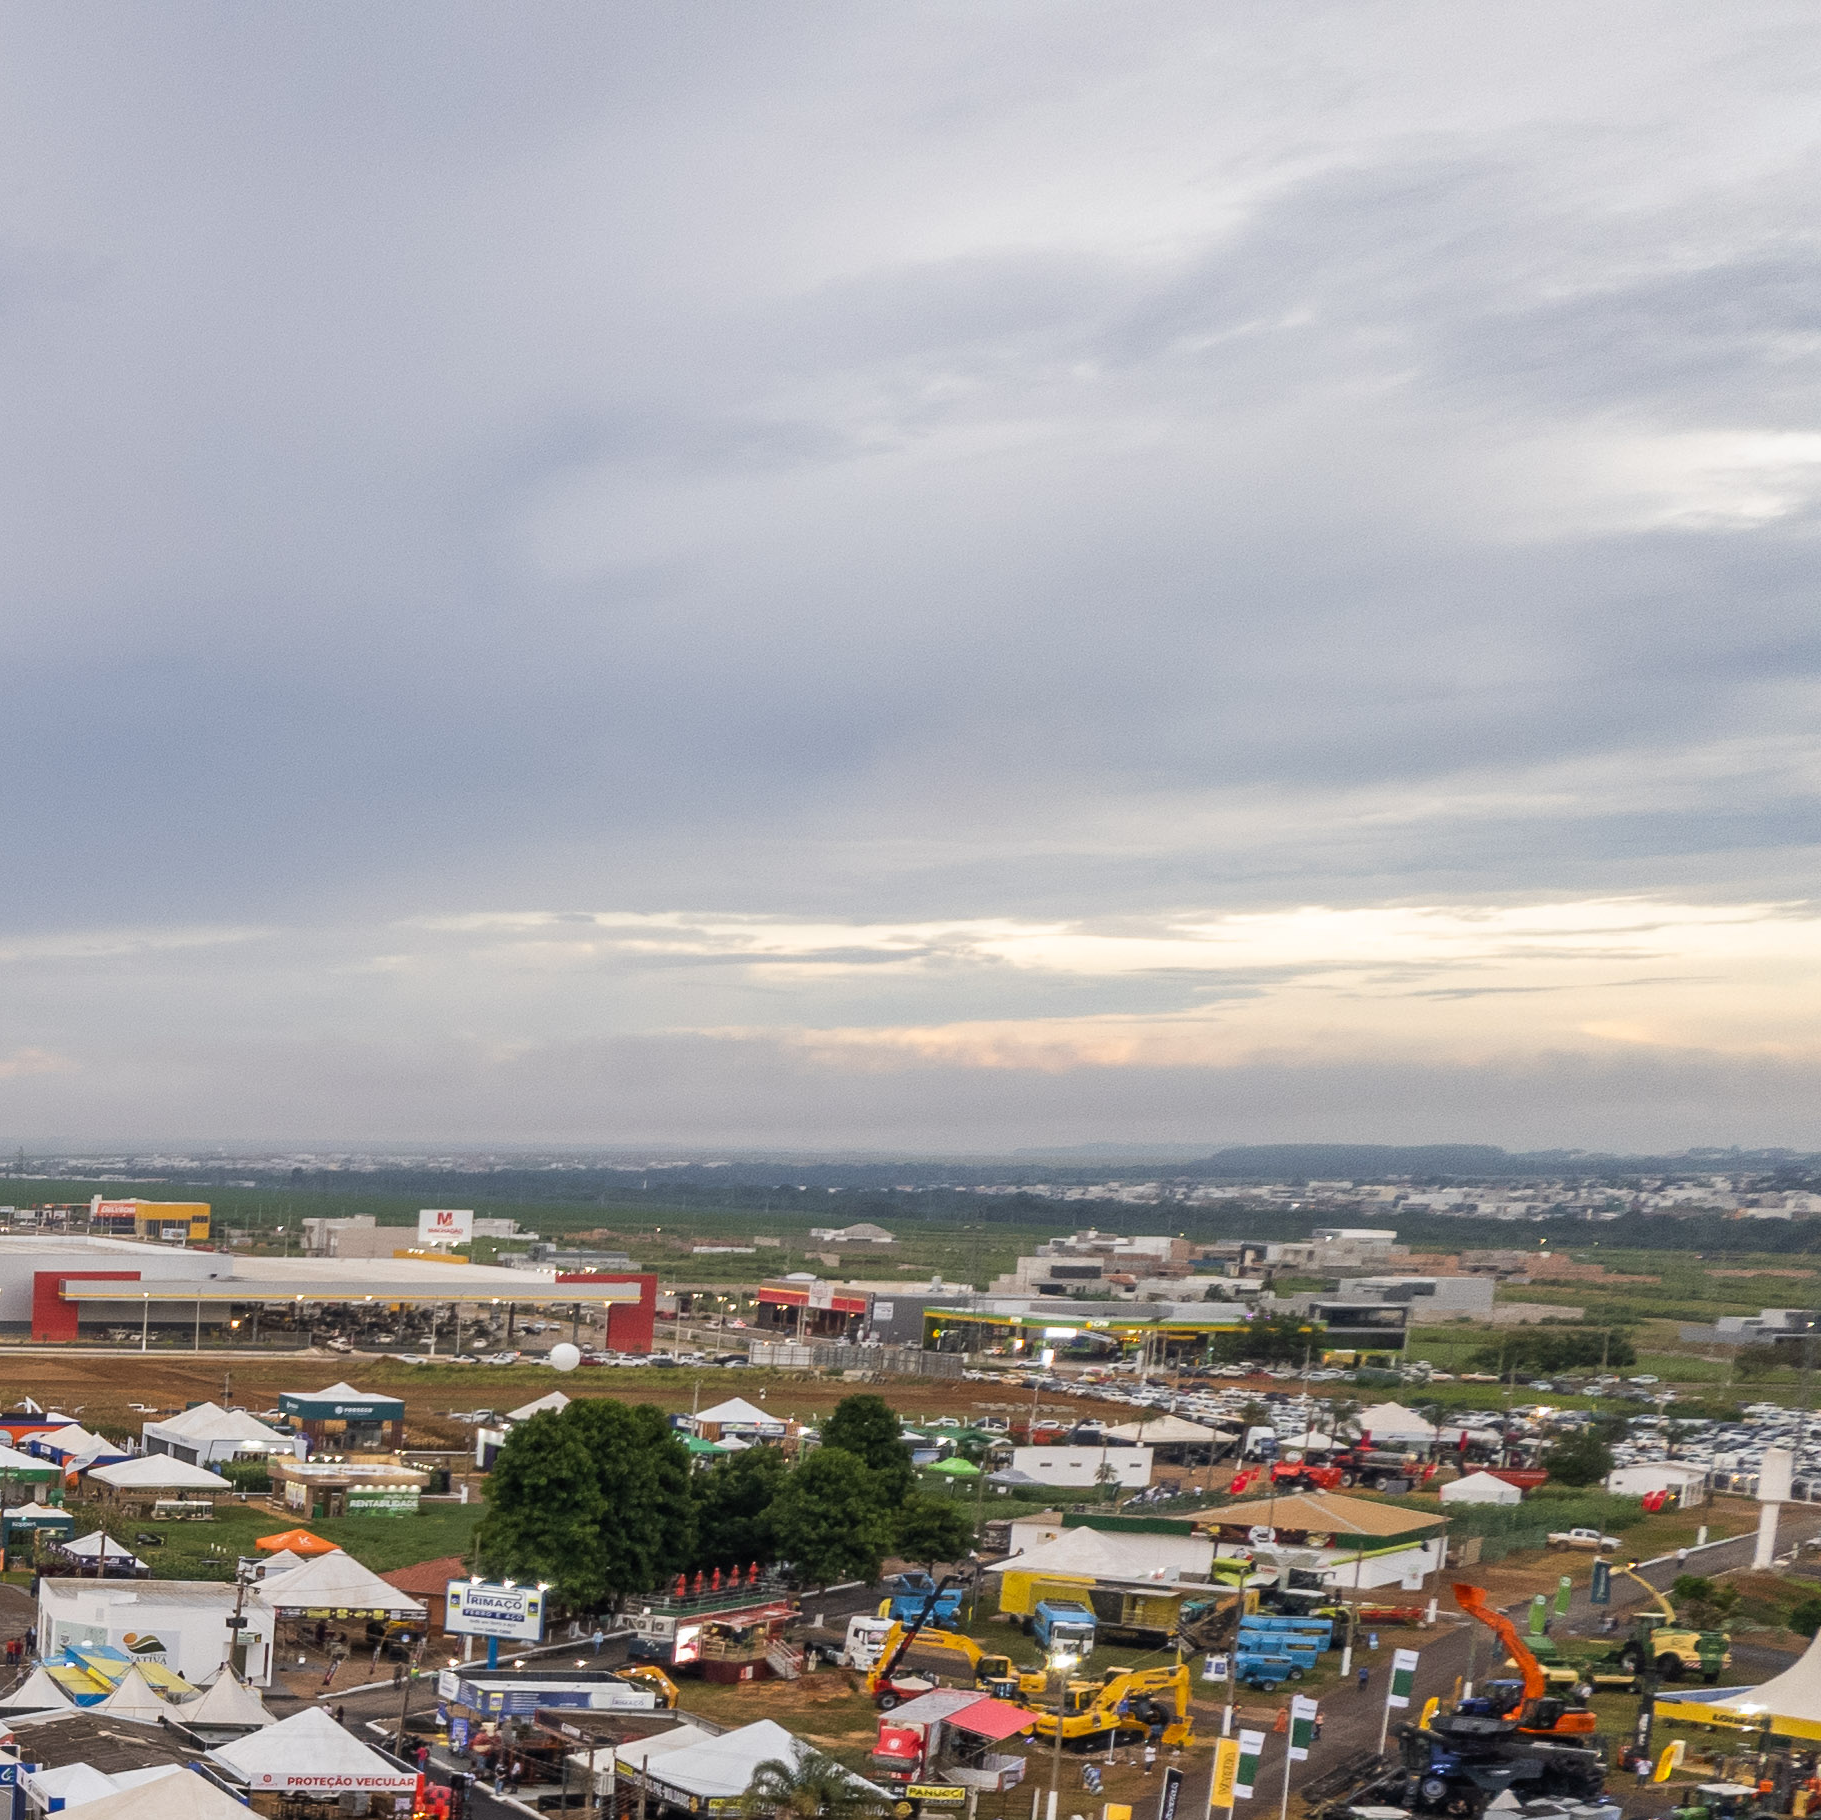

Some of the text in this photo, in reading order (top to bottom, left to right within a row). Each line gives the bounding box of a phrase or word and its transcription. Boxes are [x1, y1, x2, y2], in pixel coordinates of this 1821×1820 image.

[349, 1499, 419, 1508] RENTABILIDADE
[464, 1609, 492, 1618] FERRO
[504, 1613, 522, 1622] AÇO
[287, 1774, 415, 1788] PROTEÇÃO VEICULAR
[908, 1787, 964, 1797] PANUCCI
